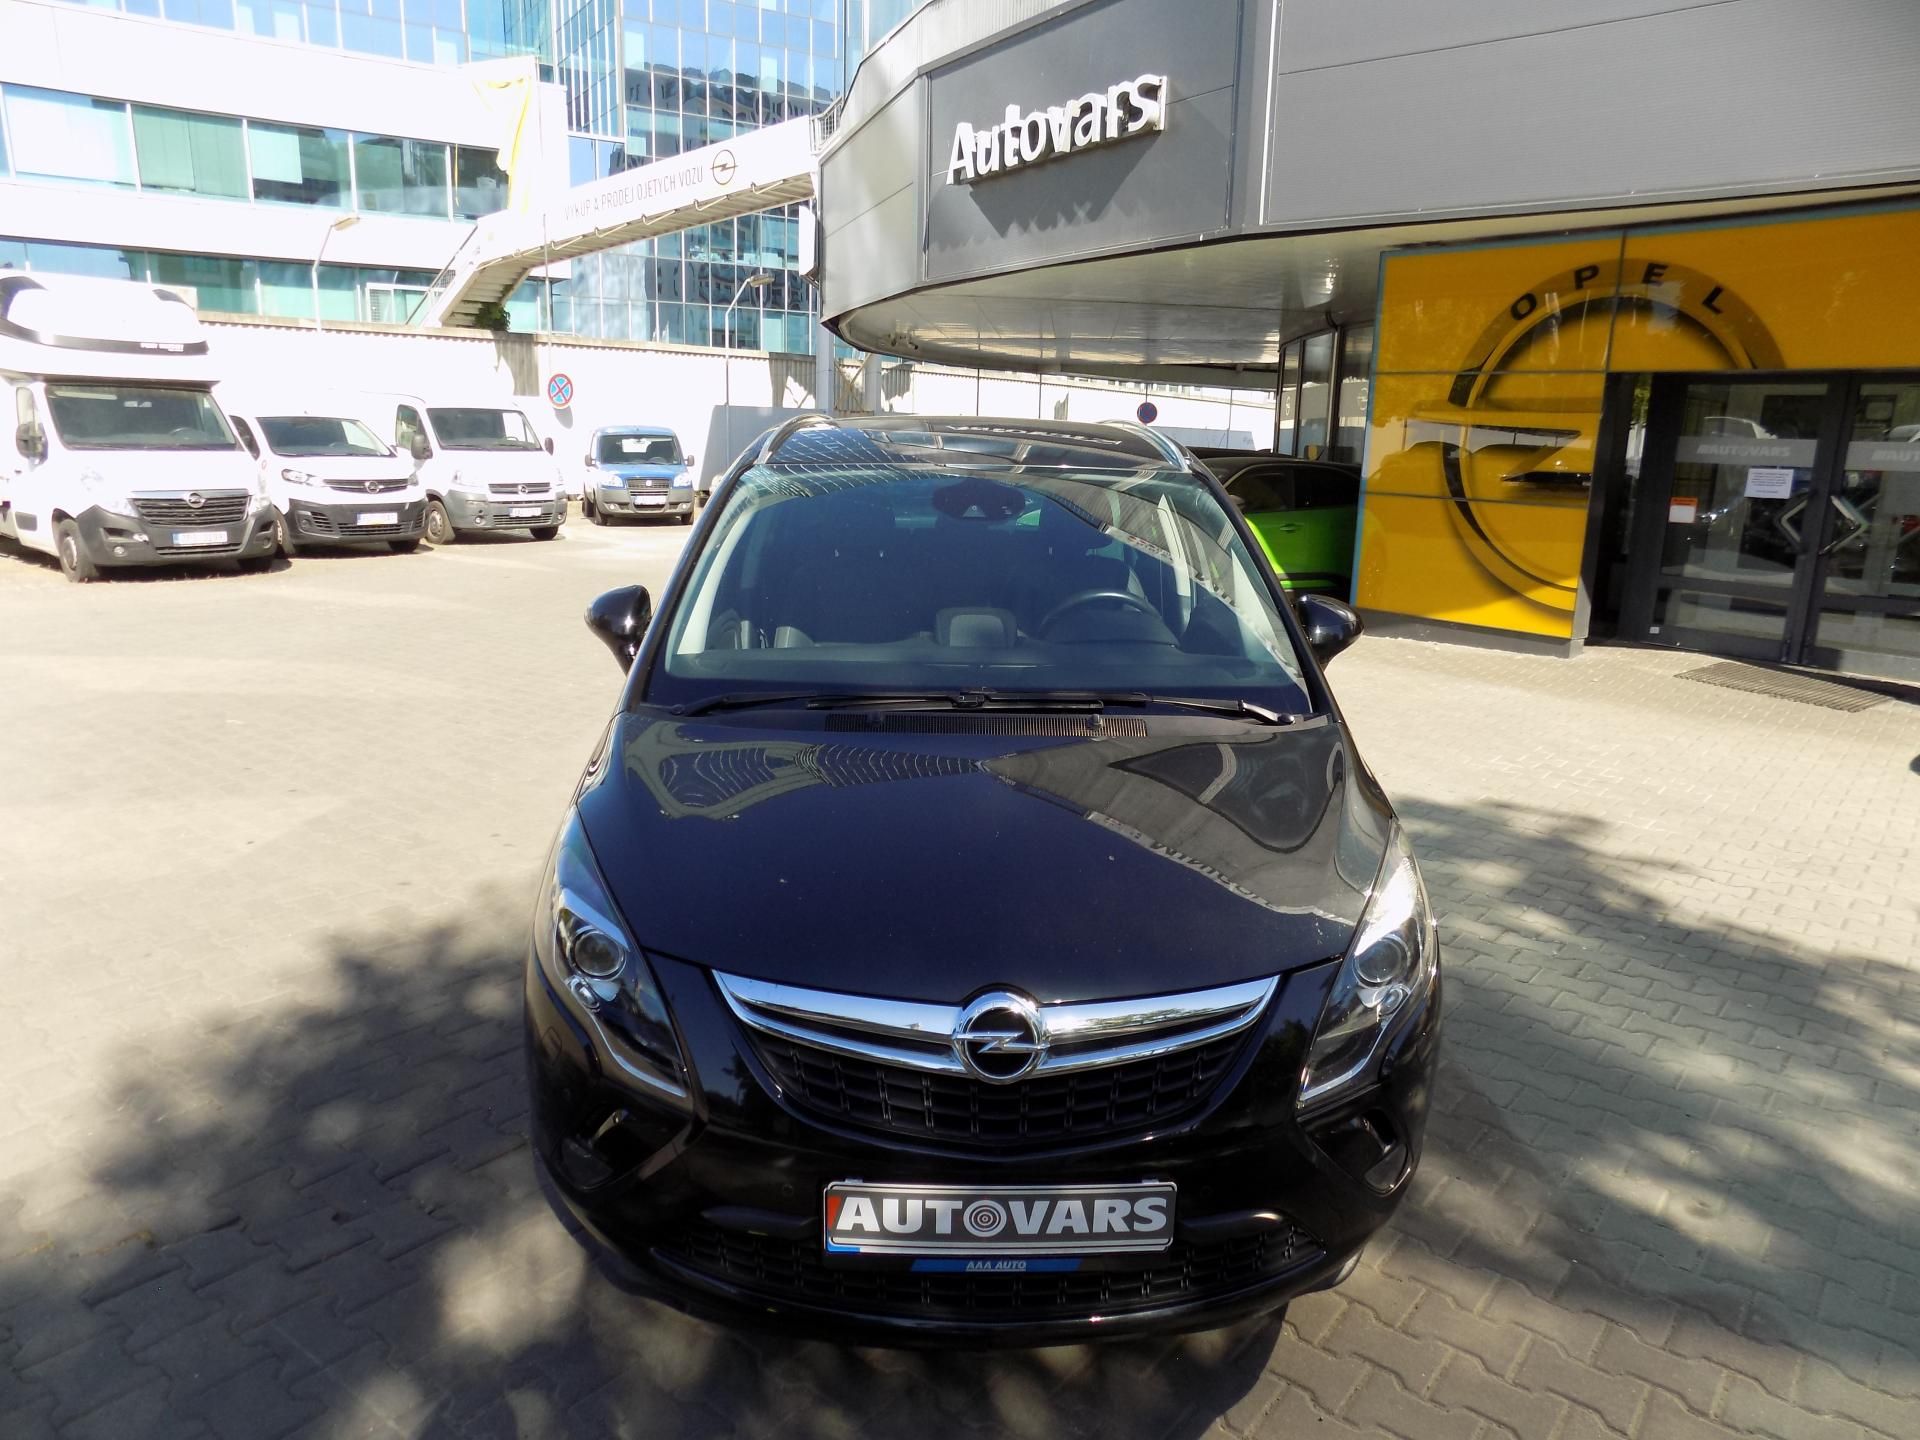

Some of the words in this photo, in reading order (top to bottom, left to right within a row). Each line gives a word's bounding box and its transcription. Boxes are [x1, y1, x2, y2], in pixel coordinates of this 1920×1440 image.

[946, 74, 1167, 184] Autovars
[1510, 262, 1725, 321] OPEL
[836, 1197, 1167, 1237] AUTOVARS
[966, 1260, 992, 1271] AAA
[995, 1260, 1027, 1271] AUTO
